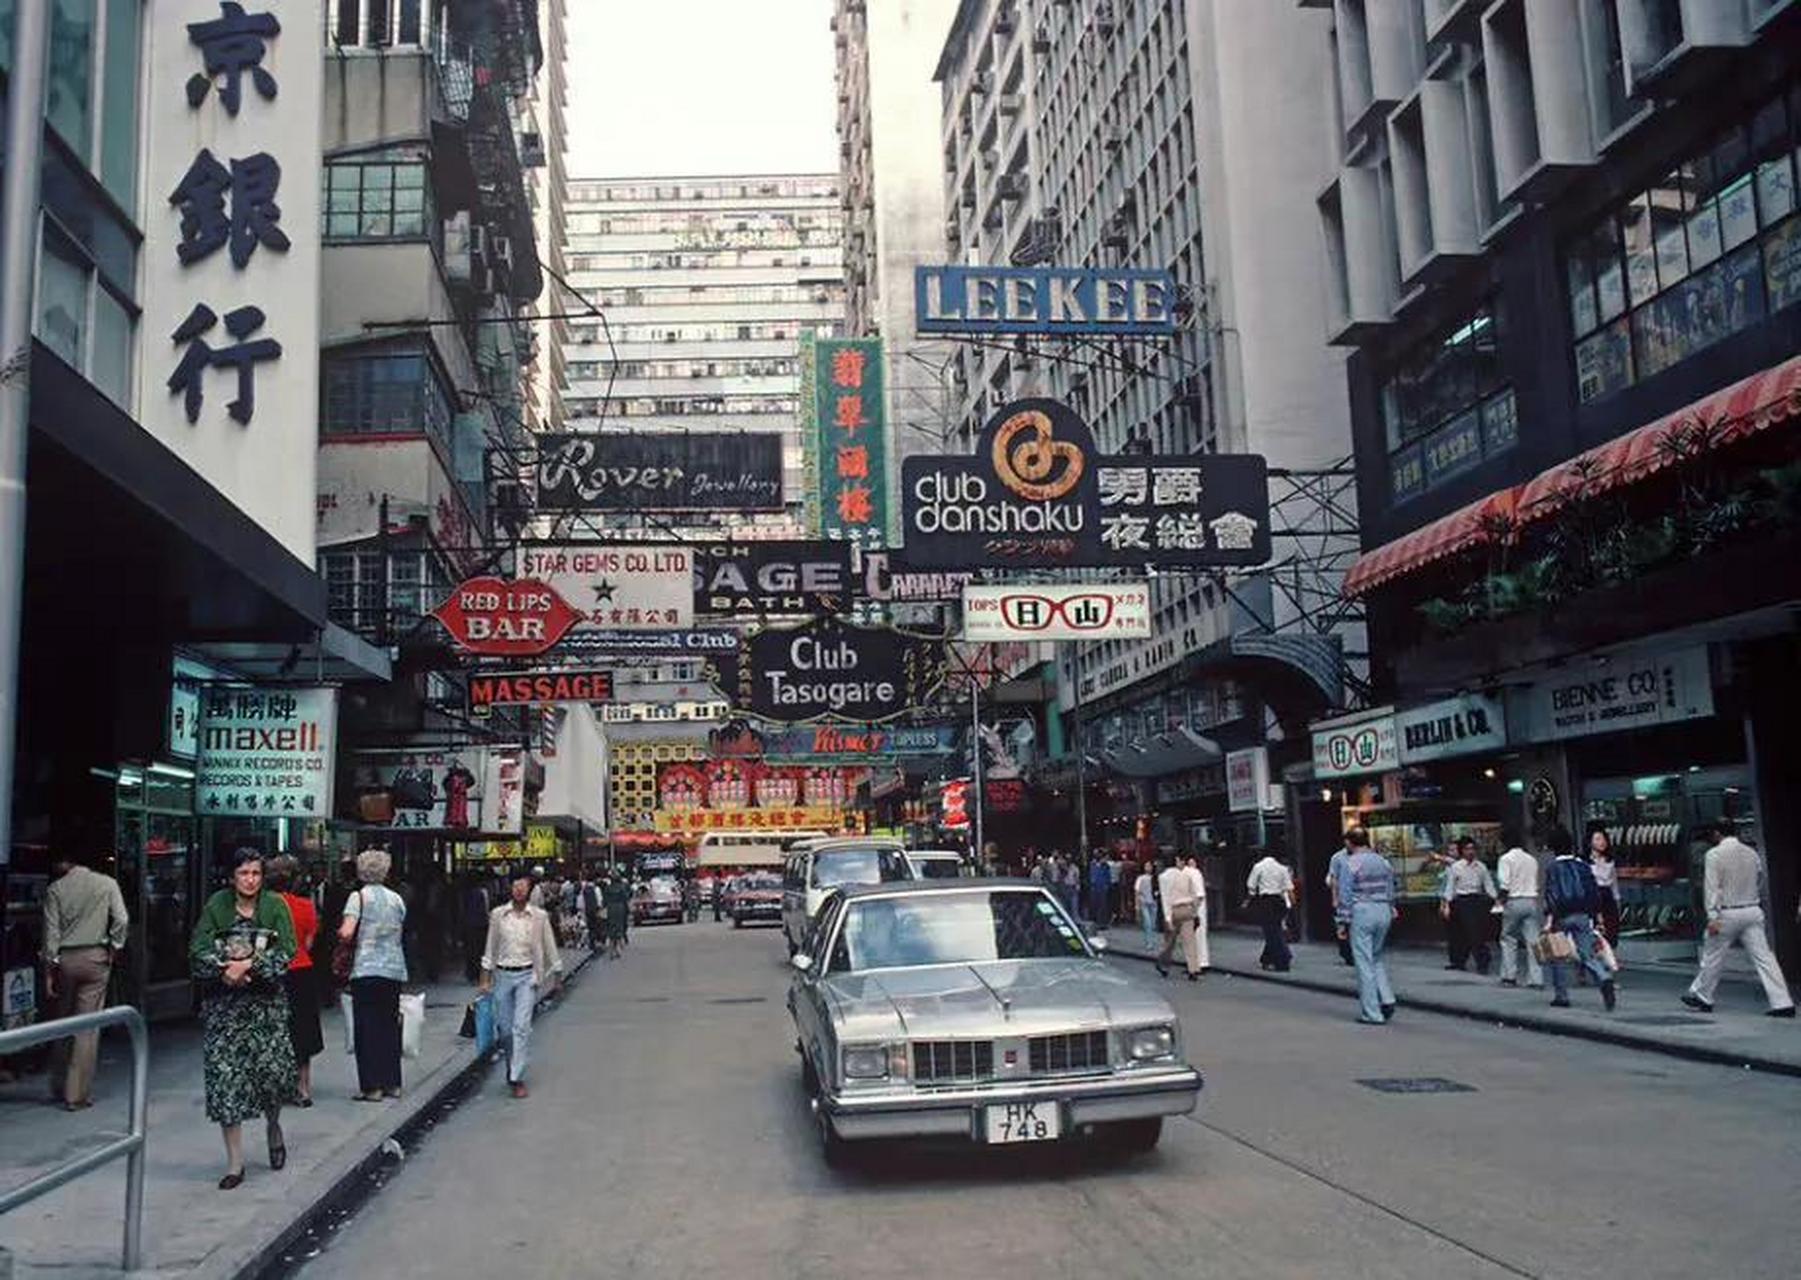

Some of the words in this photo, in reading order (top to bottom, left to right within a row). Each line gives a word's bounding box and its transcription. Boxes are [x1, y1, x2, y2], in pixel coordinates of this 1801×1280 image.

[168, 1, 290, 425] 京銀行
[540, 440, 683, 500] Rover
[915, 471, 985, 503] club
[1098, 467, 1202, 505] 男爵
[915, 501, 1084, 532] danshaku
[523, 553, 567, 573] STAR
[573, 553, 619, 573] GEMS
[655, 554, 688, 572] LTD.
[461, 592, 499, 610] RED
[507, 592, 551, 611] LIPS
[710, 596, 804, 609] BATH
[467, 616, 545, 640] BAR
[790, 636, 858, 670] Club
[471, 675, 610, 703] MASSAGE
[765, 670, 895, 709] Tasogare
[206, 721, 316, 750] maxell
[1405, 714, 1453, 750] BERLIN
[1006, 1103, 1037, 1121] HK
[998, 1121, 1047, 1140] 748
